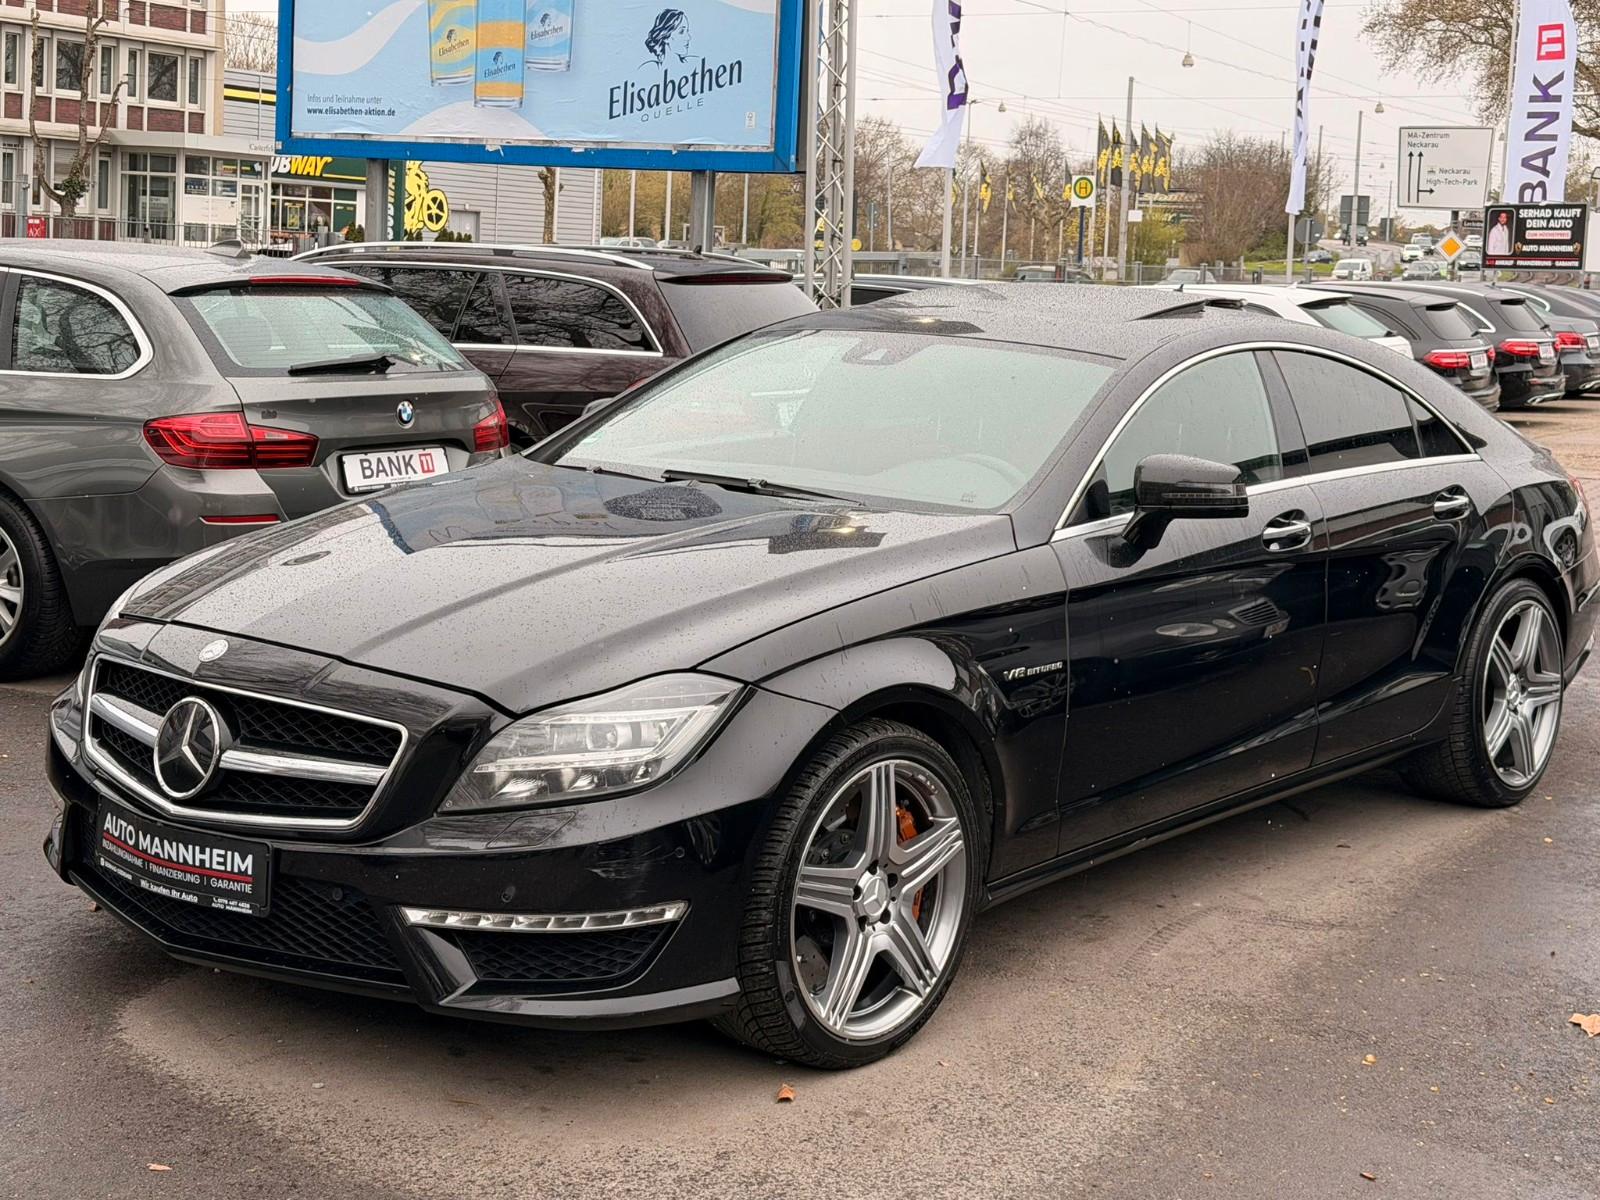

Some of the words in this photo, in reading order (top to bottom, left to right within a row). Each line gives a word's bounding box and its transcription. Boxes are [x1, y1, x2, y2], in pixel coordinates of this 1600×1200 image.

[307, 93, 321, 103] Infos
[323, 94, 334, 103] und
[335, 94, 365, 104] Teilnahme
[366, 96, 382, 105] unter
[608, 57, 742, 120] Elisabethen
[307, 106, 396, 116] www.elisabethen-aktion.de
[640, 97, 704, 123] QUELLE
[1518, 70, 1565, 203] BANK
[271, 155, 333, 177] UBWAY
[1079, 181, 1088, 195] H
[1426, 178, 1478, 187] High-Tech-Park
[1519, 208, 1552, 218] SERHAD
[1554, 208, 1582, 218] KAUFT
[1526, 219, 1547, 228] DEIN
[1548, 219, 1573, 228] AUTO
[359, 454, 418, 480] BANK
[103, 812, 136, 845] AUTO
[138, 830, 253, 875] MANNHEIM
[140, 878, 149, 888] Wir
[150, 883, 171, 896] kaufen
[171, 888, 180, 898] Ihr
[182, 891, 198, 903] Auto
[149, 864, 201, 884] FINANZIERUNG
[210, 877, 253, 894] GARANTIE
